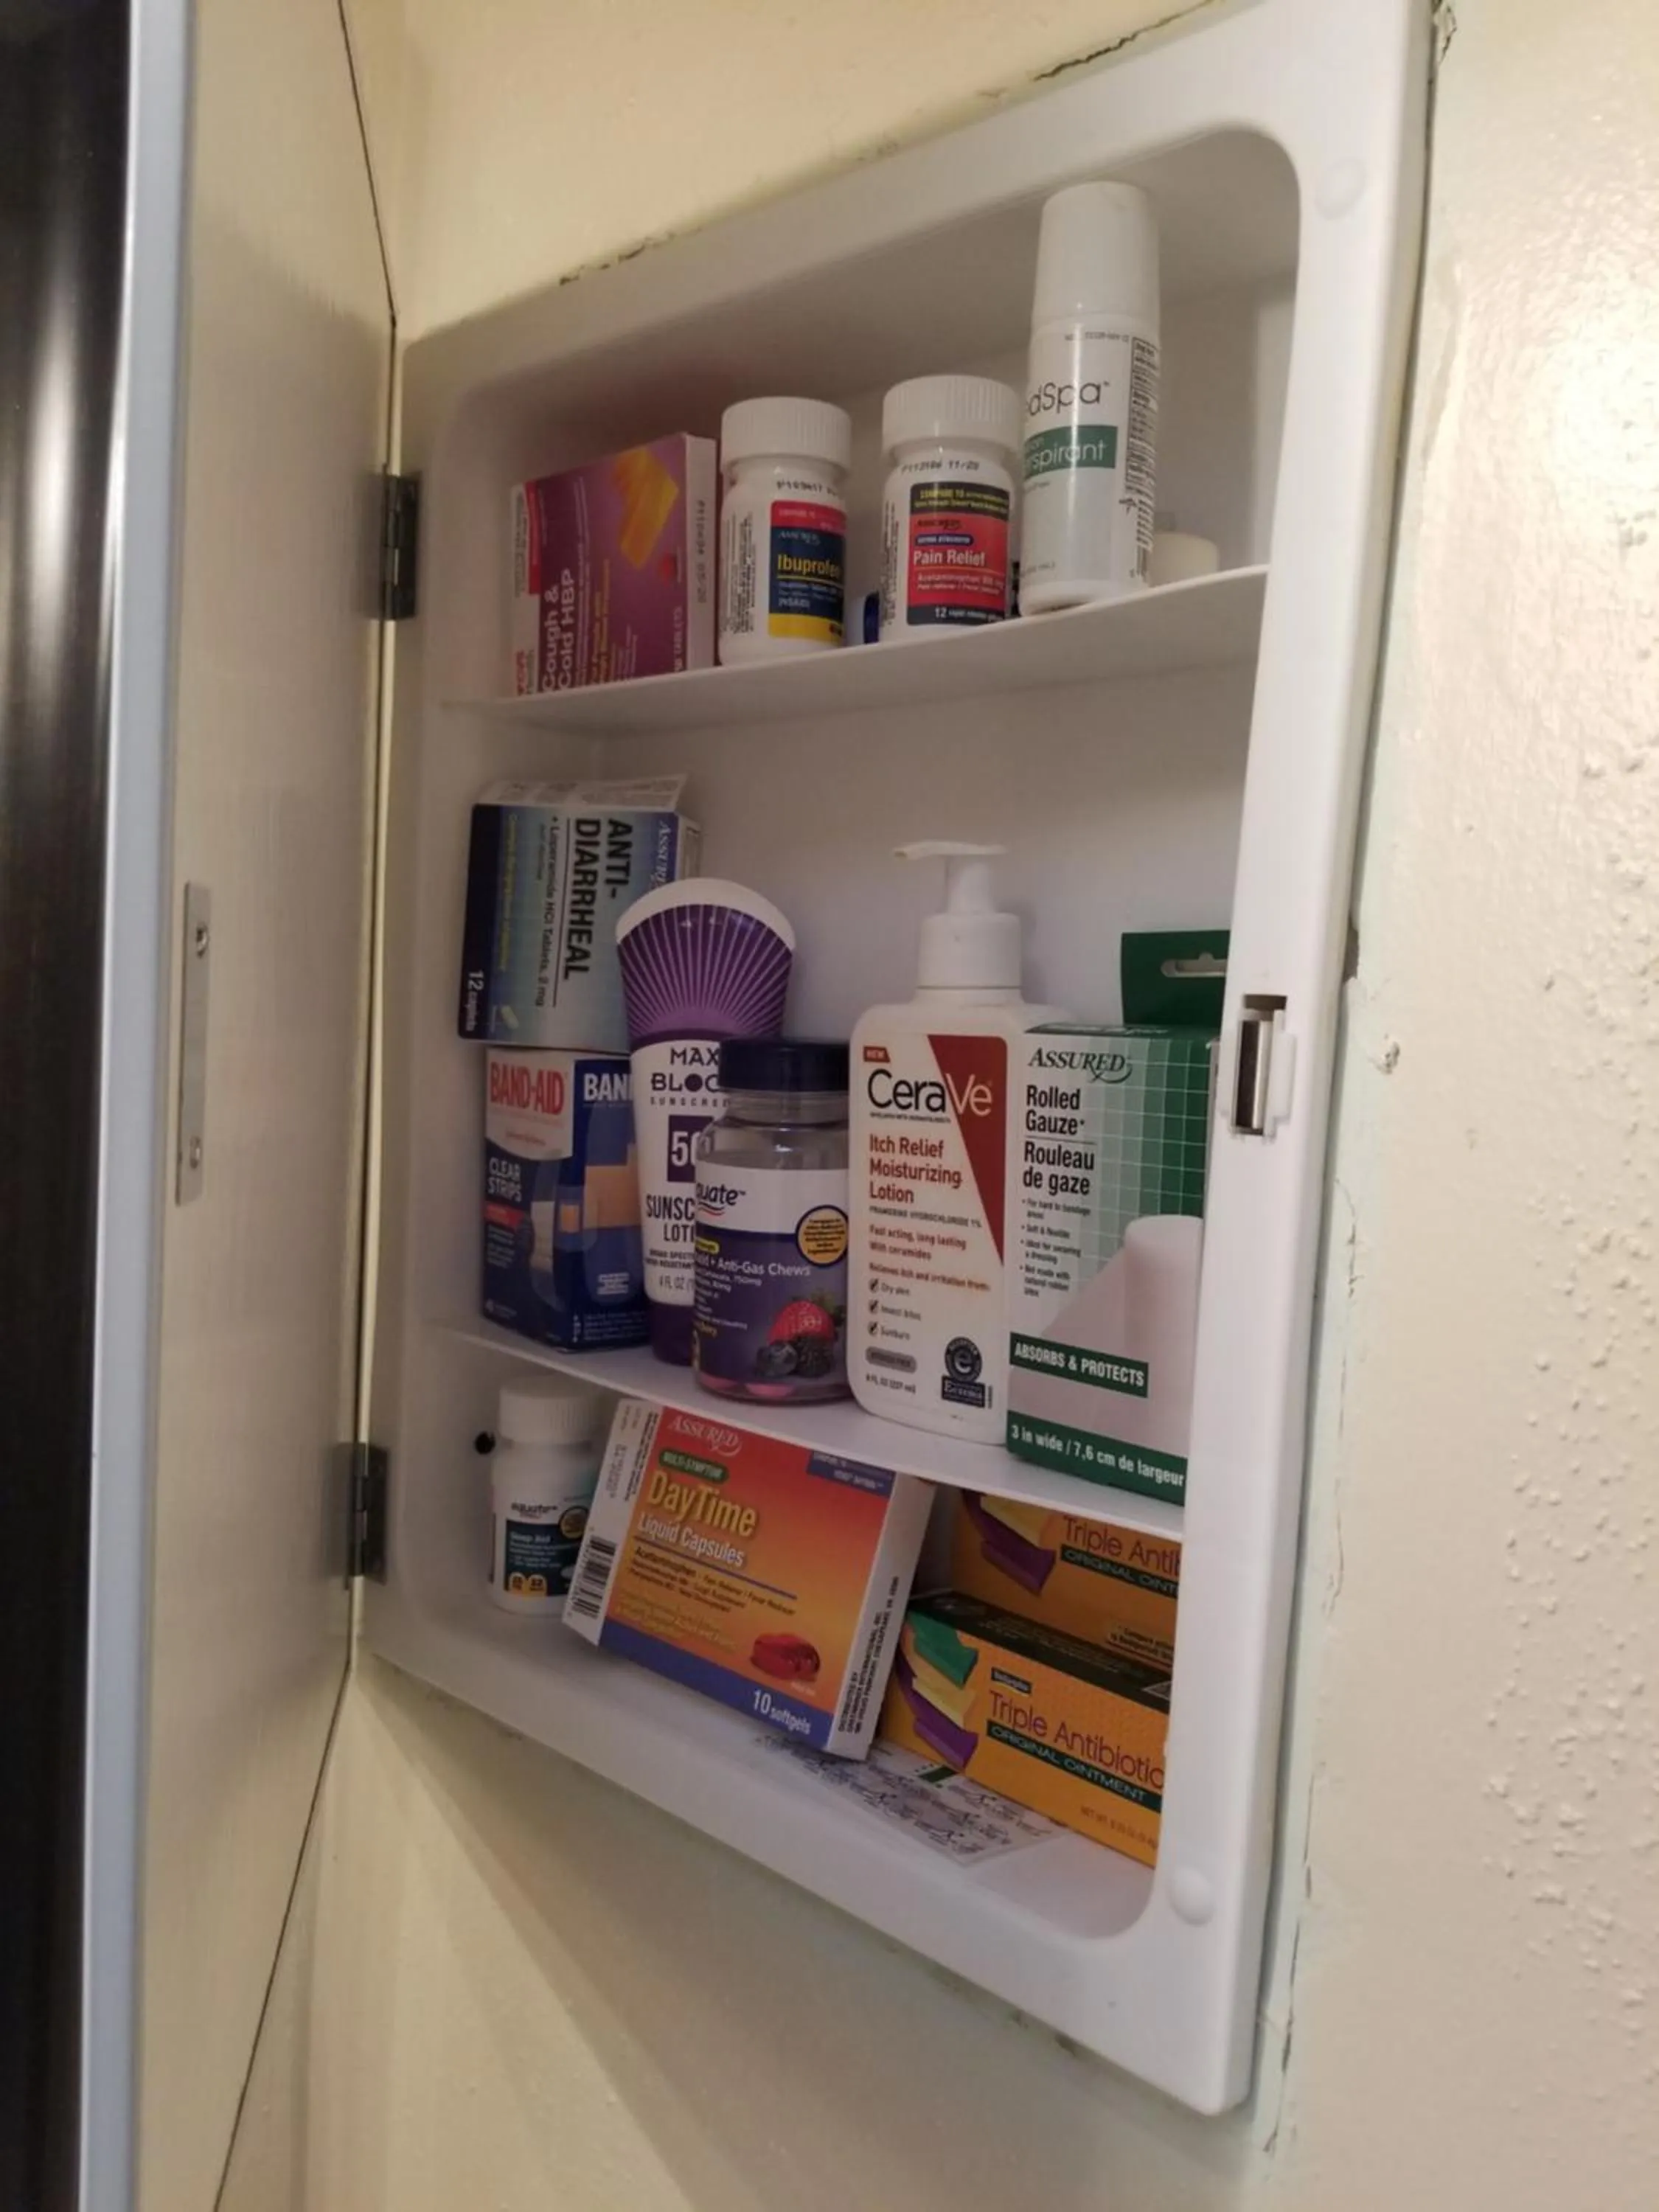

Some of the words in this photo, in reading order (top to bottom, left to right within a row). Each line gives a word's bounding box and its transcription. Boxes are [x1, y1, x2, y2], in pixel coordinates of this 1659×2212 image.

[914, 549, 944, 567] Pain
[946, 549, 986, 566] Relief
[544, 583, 560, 602] &
[561, 568, 575, 625] HBP
[934, 606, 947, 619] 12
[542, 608, 560, 692] Cough
[557, 631, 574, 690] Cold
[603, 818, 633, 900] ANTI-
[563, 818, 602, 981] DIARRHEAL
[467, 970, 484, 991] 12
[669, 1046, 720, 1067] MAX
[866, 1048, 885, 1060] NEW
[1027, 1046, 1133, 1082] ASSURED
[490, 1061, 566, 1116] BAND-AID
[650, 1072, 720, 1093] BLOC
[867, 1067, 993, 1118] CeraVe
[1026, 1084, 1081, 1110] Rolled
[869, 1133, 896, 1155] Itch
[899, 1136, 944, 1159] Relief
[1023, 1140, 1096, 1172] Rouleau
[488, 1156, 521, 1180] CLEAR
[869, 1158, 962, 1189] Moisturizing
[1023, 1166, 1043, 1190] de
[1048, 1172, 1091, 1197] gaze
[487, 1175, 523, 1204] STRIPS
[869, 1181, 914, 1204] Lotion
[869, 1224, 886, 1237] Fast
[887, 1227, 914, 1242] acting,
[717, 1257, 765, 1276] Anti-Gas
[768, 1262, 811, 1277] Chews
[915, 1269, 930, 1281] and
[1014, 1342, 1065, 1368] ABSORBS
[1068, 1354, 1077, 1371] &
[1080, 1357, 1145, 1388] PROTECTS
[667, 1415, 742, 1455] ASSURED
[1011, 1425, 1019, 1439] 3
[1022, 1427, 1033, 1443] in
[1034, 1430, 1062, 1453] wide
[1074, 1441, 1094, 1461] 7,6
[1096, 1450, 1116, 1467] cm
[1118, 1455, 1135, 1472] de
[1136, 1458, 1185, 1487] largeur
[647, 1469, 757, 1537] DayTime
[637, 1512, 679, 1545] Liquid
[680, 1525, 746, 1568] Capsules
[1062, 1514, 1124, 1557] Triple
[1065, 1549, 1134, 1582] ORIGINAL
[753, 1688, 773, 1714] 10
[988, 1689, 1048, 1738] Triple
[1053, 1721, 1164, 1790] Antibiotic
[992, 1724, 1060, 1764] ORIGINAL
[1064, 1758, 1147, 1802] OINTMENT
